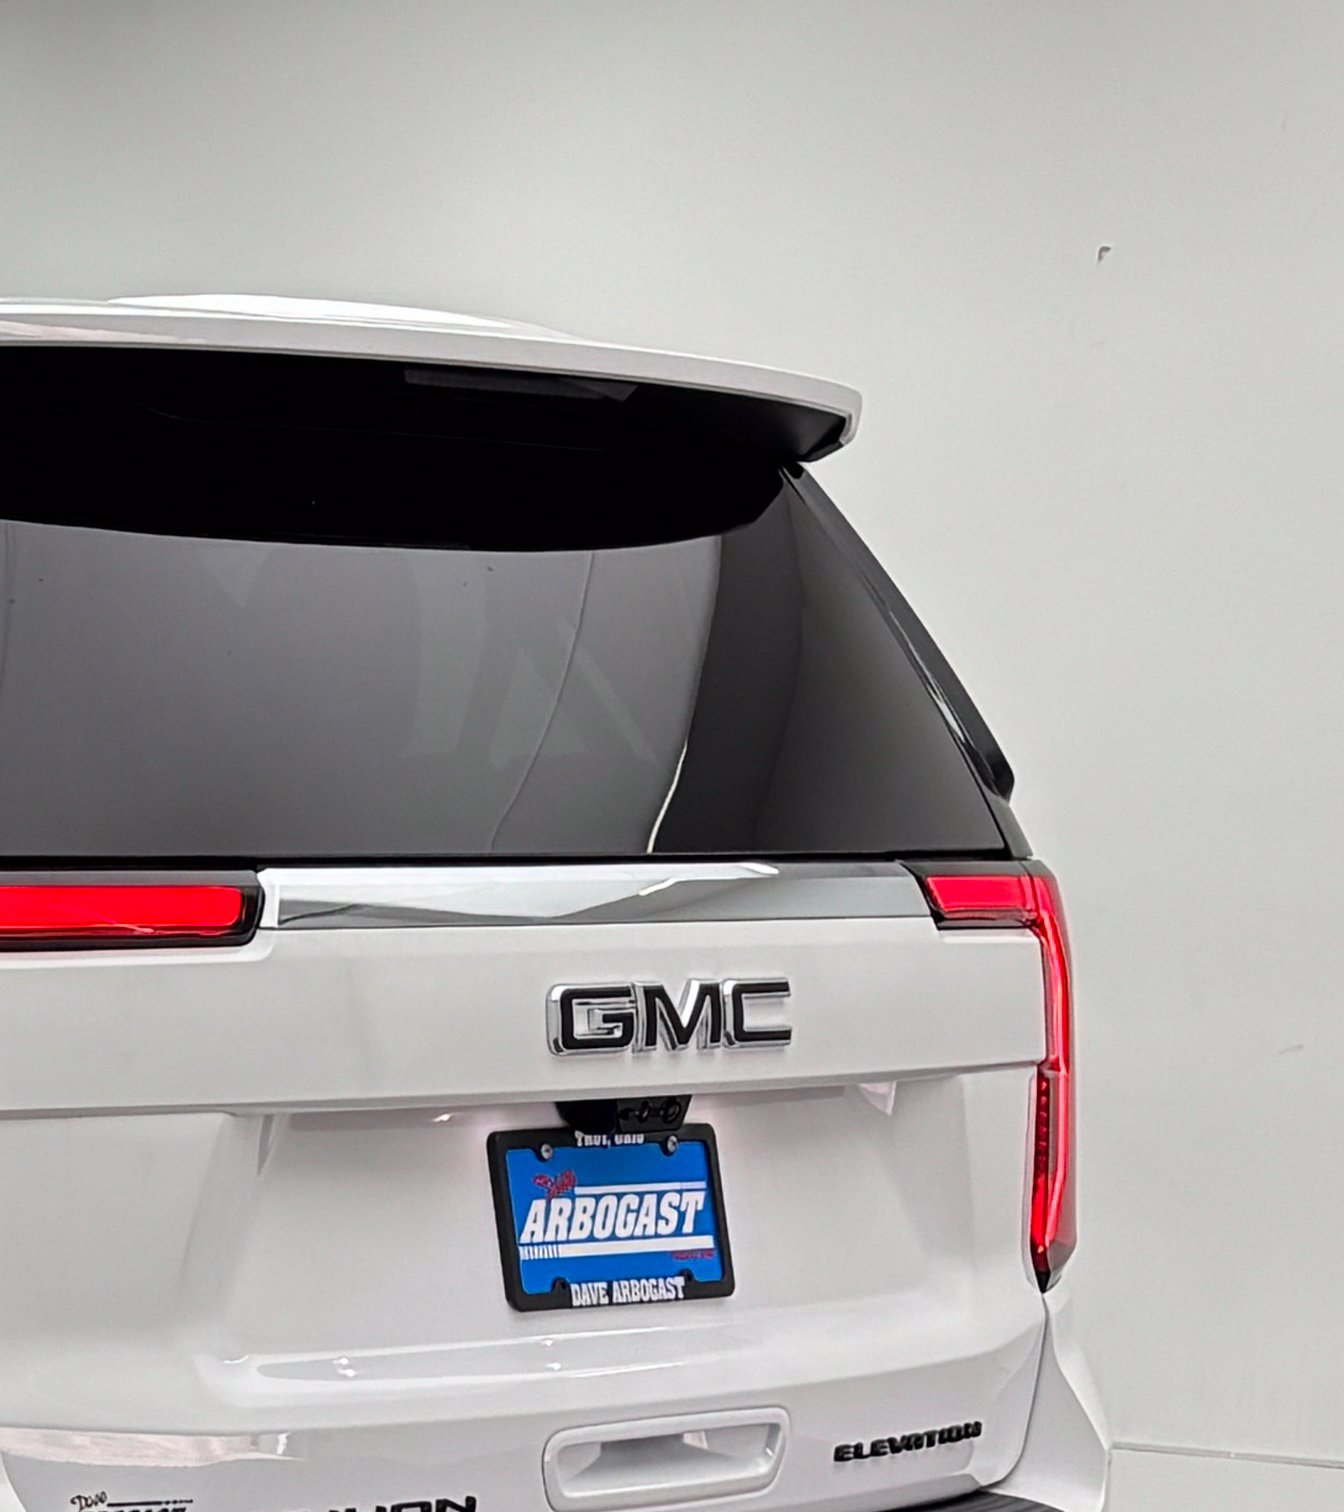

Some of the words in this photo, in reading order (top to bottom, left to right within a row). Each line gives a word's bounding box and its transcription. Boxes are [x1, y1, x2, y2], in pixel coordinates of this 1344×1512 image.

[545, 977, 792, 1056] GMC
[520, 1191, 706, 1244] ARBOGAST
[570, 1281, 610, 1307] DAVE
[612, 1275, 686, 1304] ARBOGAST
[833, 1420, 983, 1462] ELEVATION
